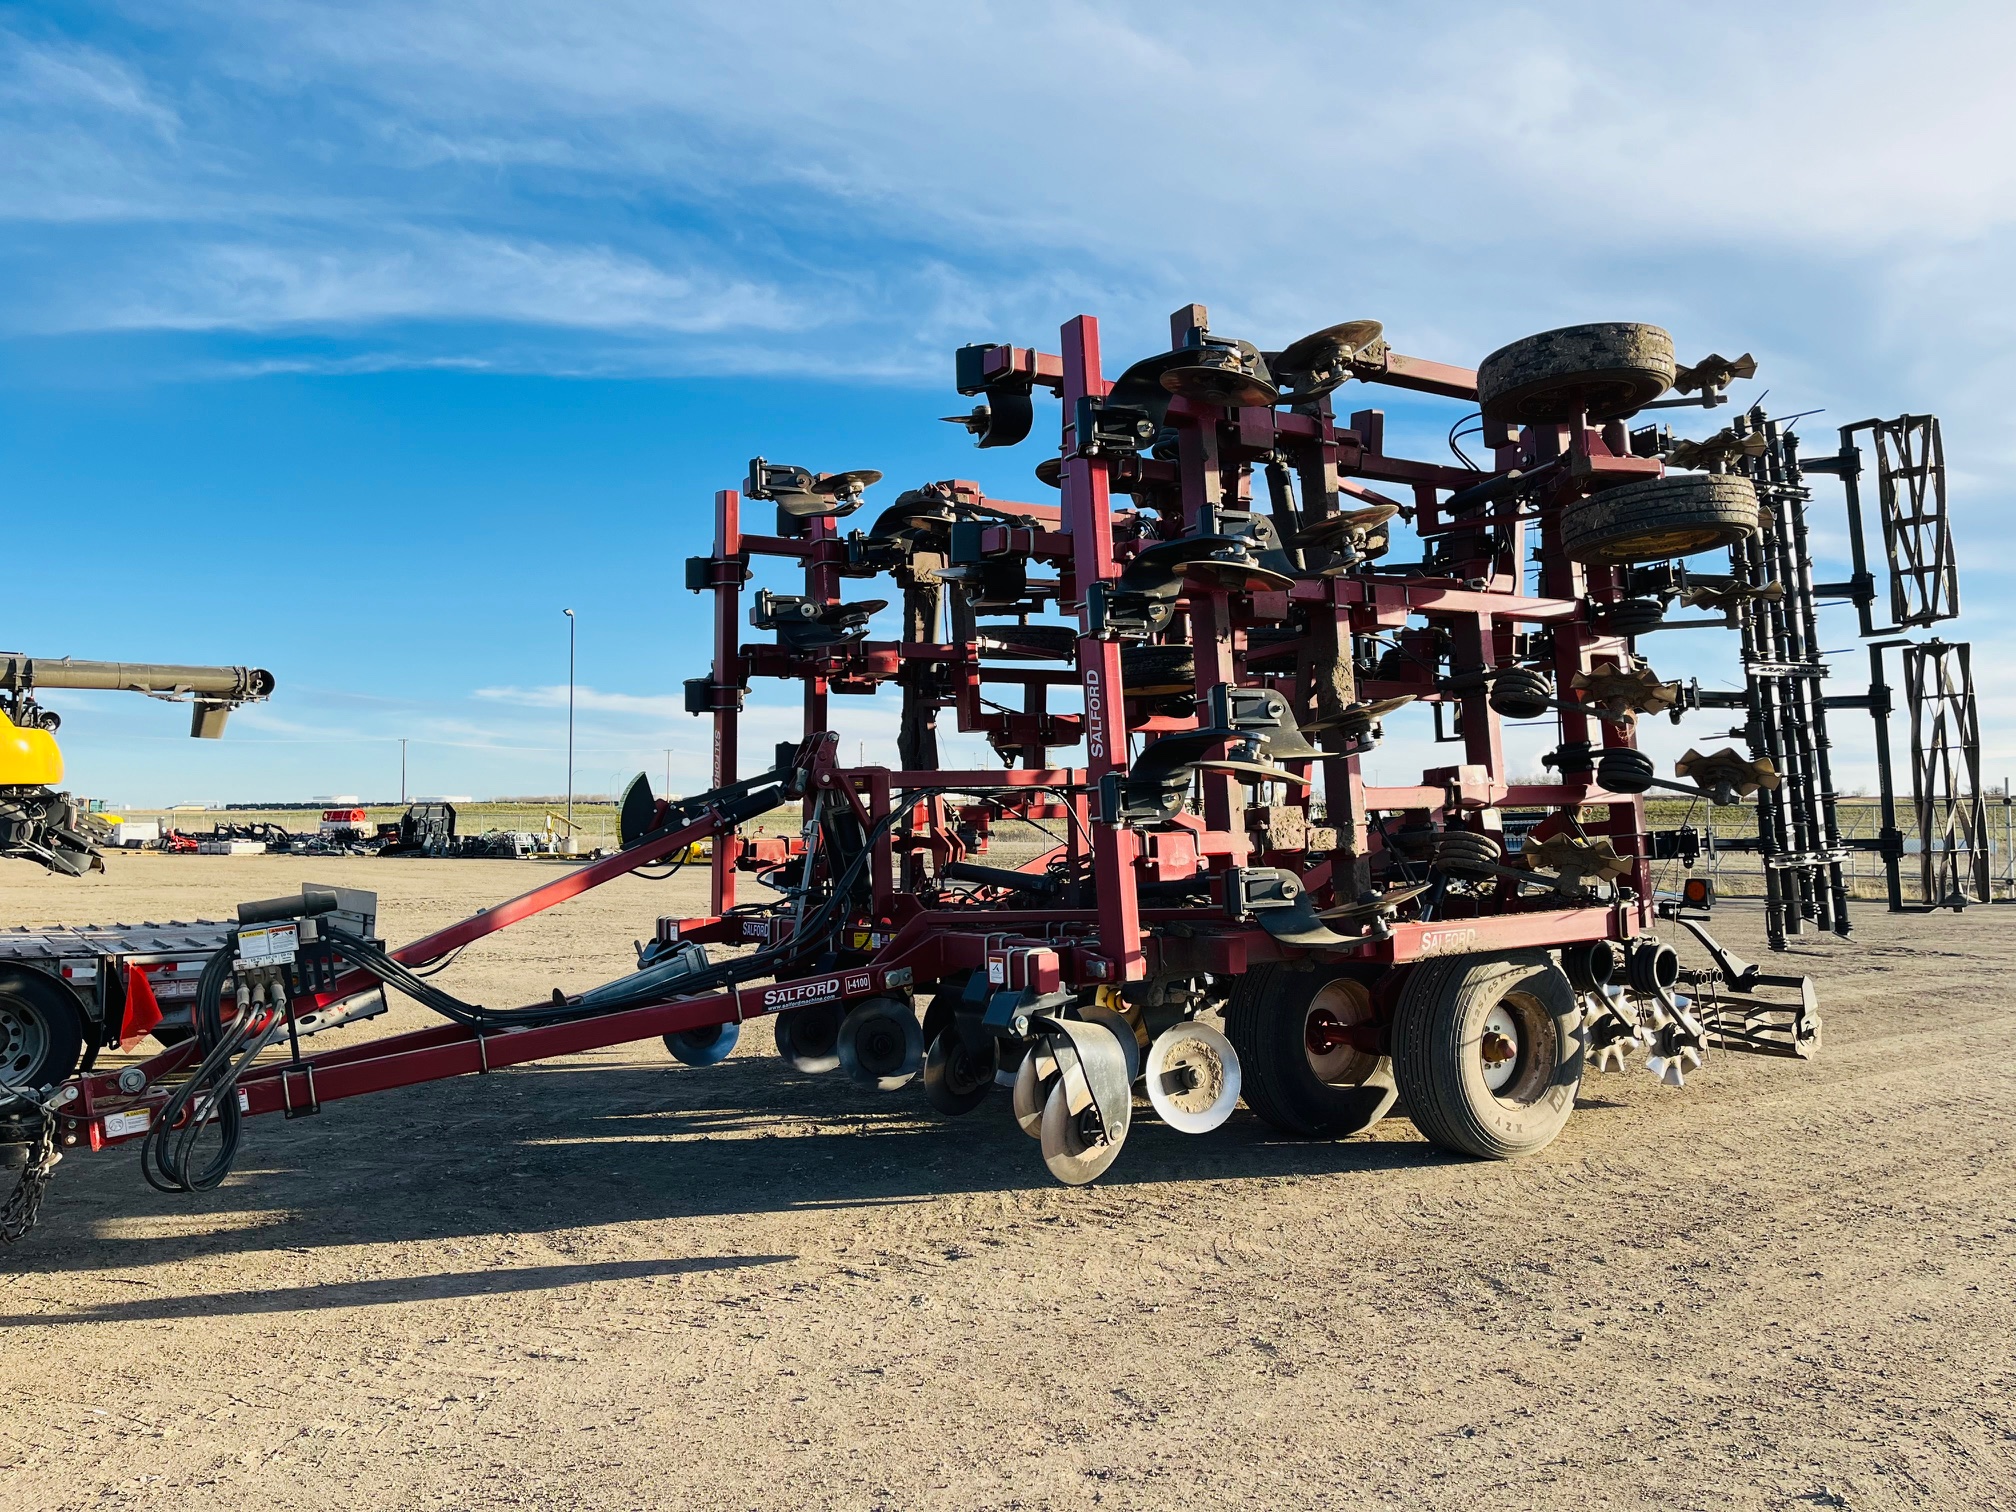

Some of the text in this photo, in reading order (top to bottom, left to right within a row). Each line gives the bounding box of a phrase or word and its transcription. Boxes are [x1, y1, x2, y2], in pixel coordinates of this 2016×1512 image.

[1086, 669, 1104, 758] SALFORD
[742, 921, 769, 937] SALFORD
[1421, 928, 1476, 950] SALFORD
[764, 977, 868, 1005] SALFORD I-4100
[767, 994, 836, 1011] www.salfordmachine.com
